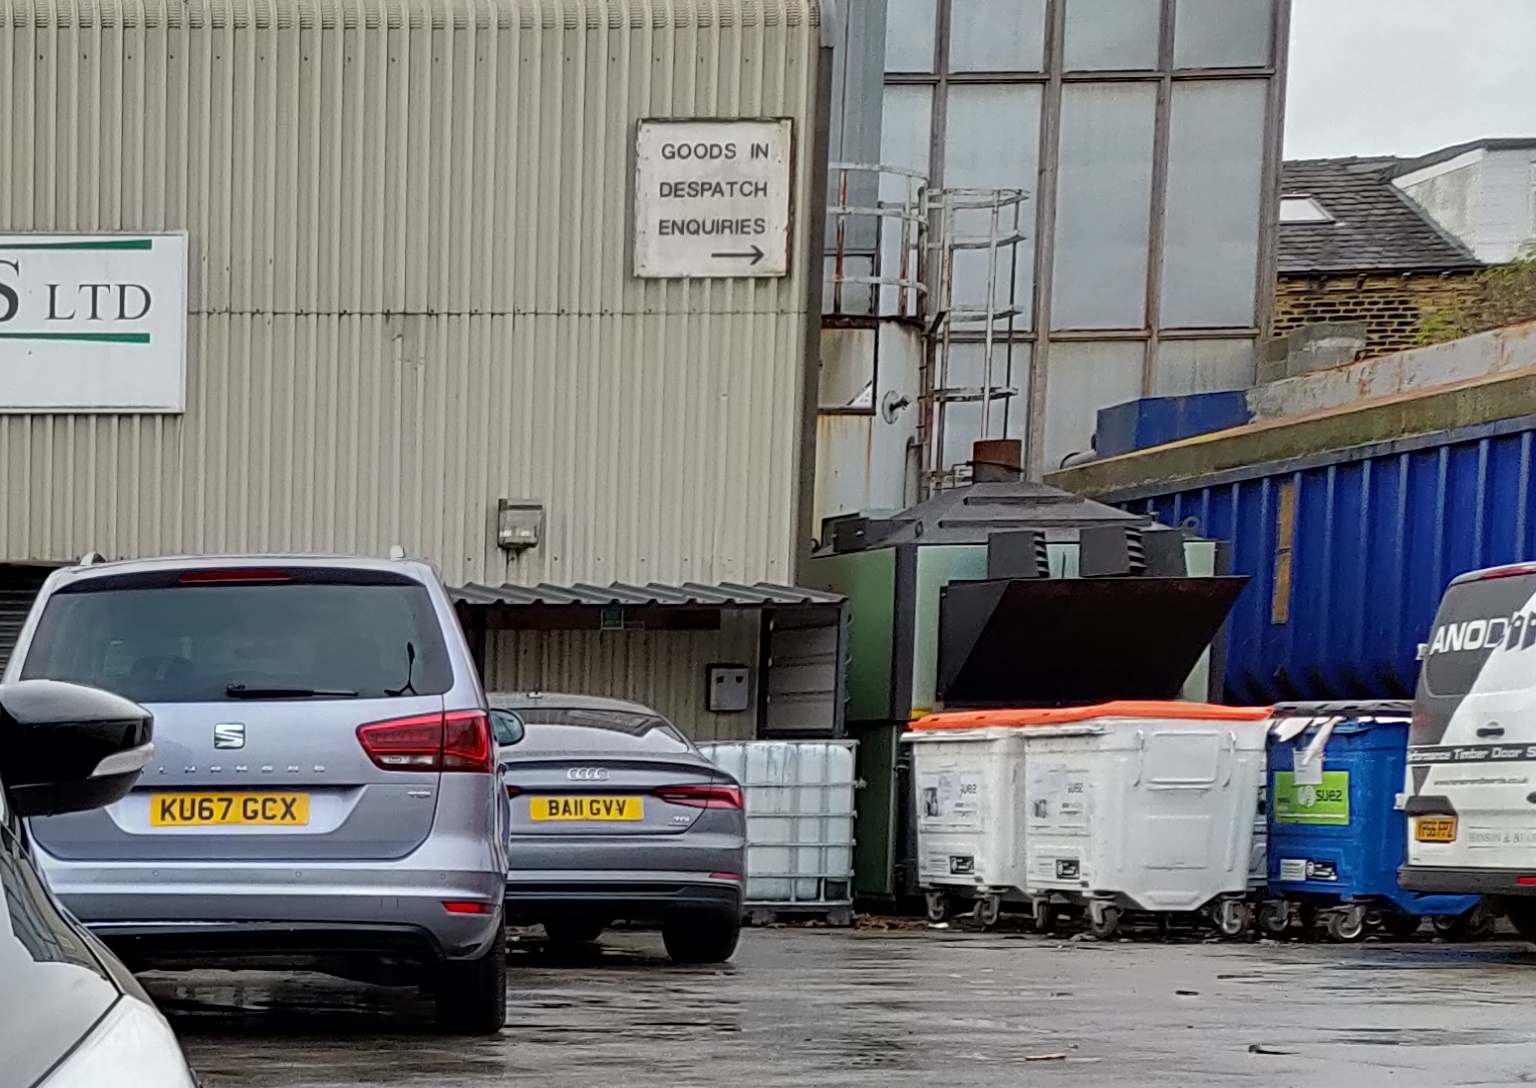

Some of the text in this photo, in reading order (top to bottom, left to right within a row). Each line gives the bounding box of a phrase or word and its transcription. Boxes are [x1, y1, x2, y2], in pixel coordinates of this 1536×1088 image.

[661, 142, 769, 160] GOODS IN
[659, 181, 768, 198] DESPATCH
[658, 218, 766, 236] ENQUIRIES
[44, 282, 153, 322] LTD
[1491, 747, 1523, 758] Door
[160, 797, 297, 821] KU67 GCX
